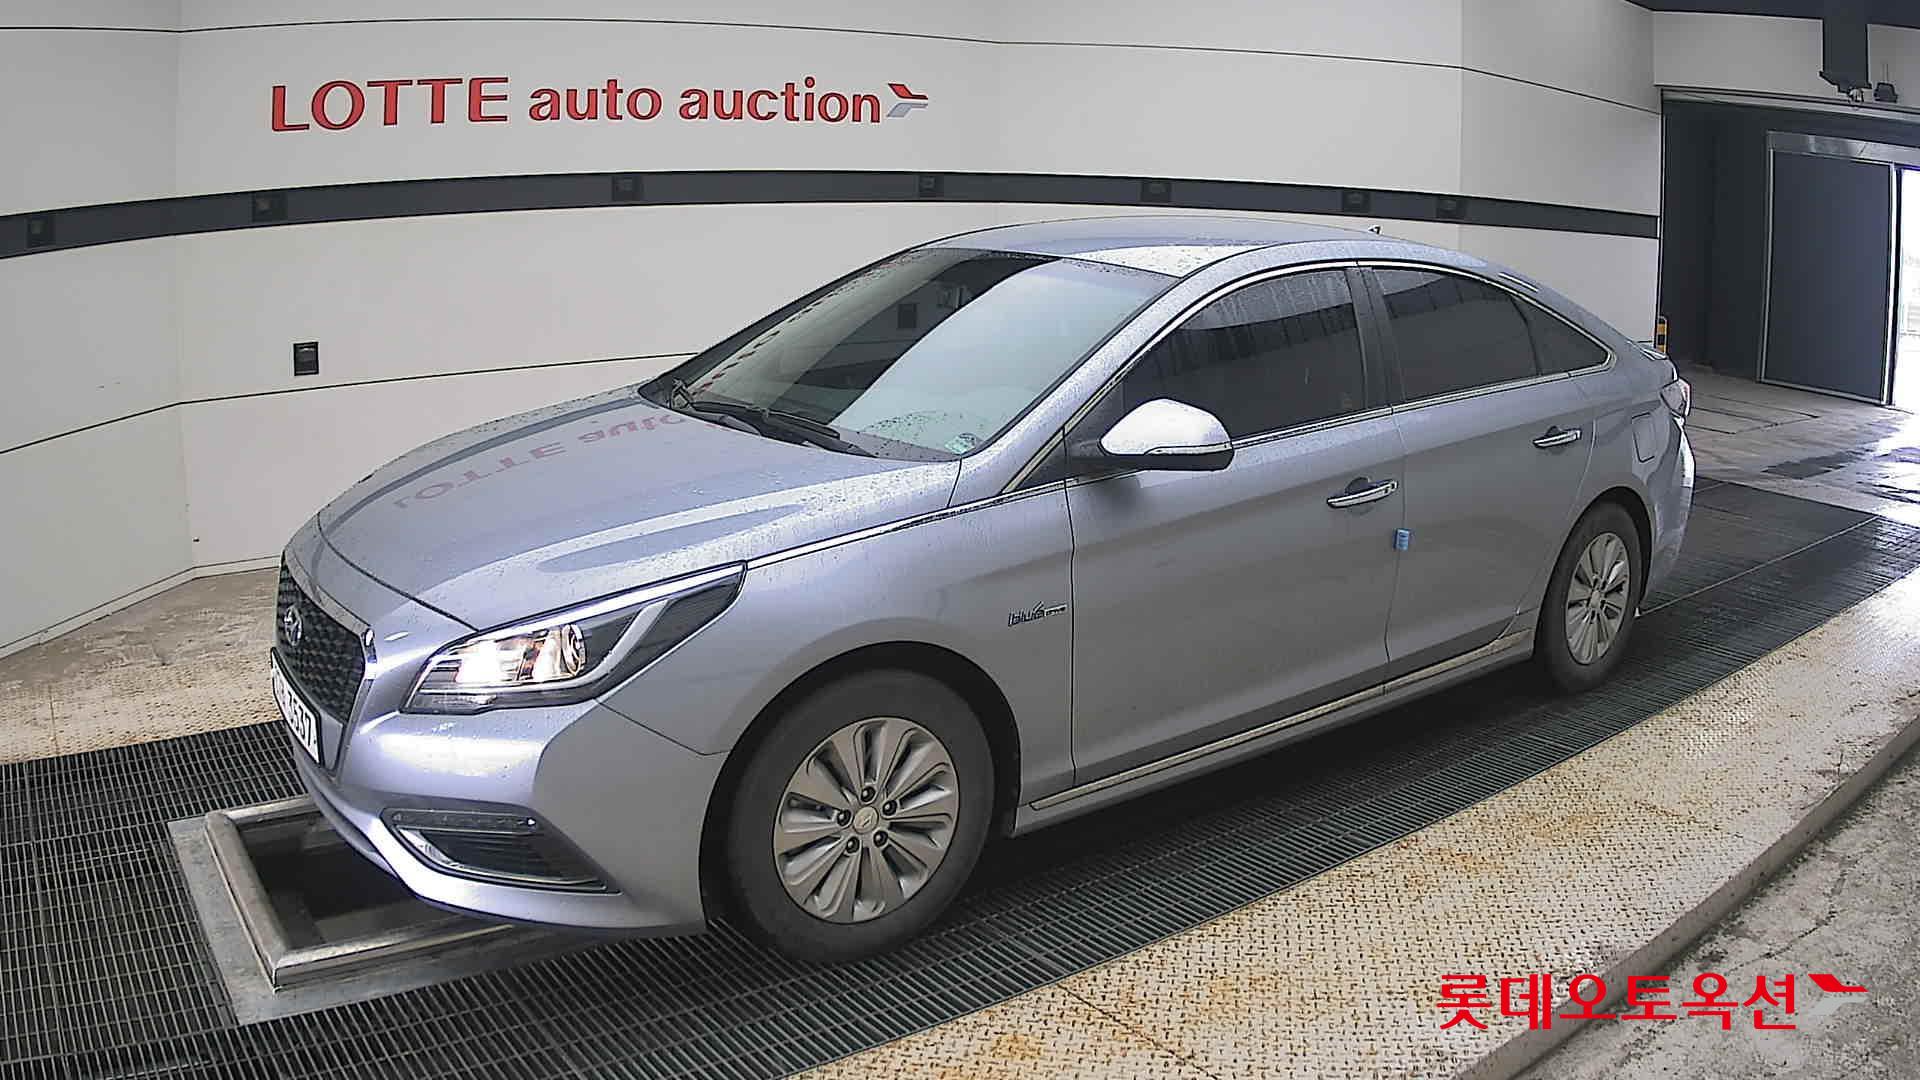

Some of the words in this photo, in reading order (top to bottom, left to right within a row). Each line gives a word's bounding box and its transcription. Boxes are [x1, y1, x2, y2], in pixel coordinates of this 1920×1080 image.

[271, 77, 508, 131] LOTTE
[528, 79, 662, 121] auto
[679, 76, 881, 123] auction
